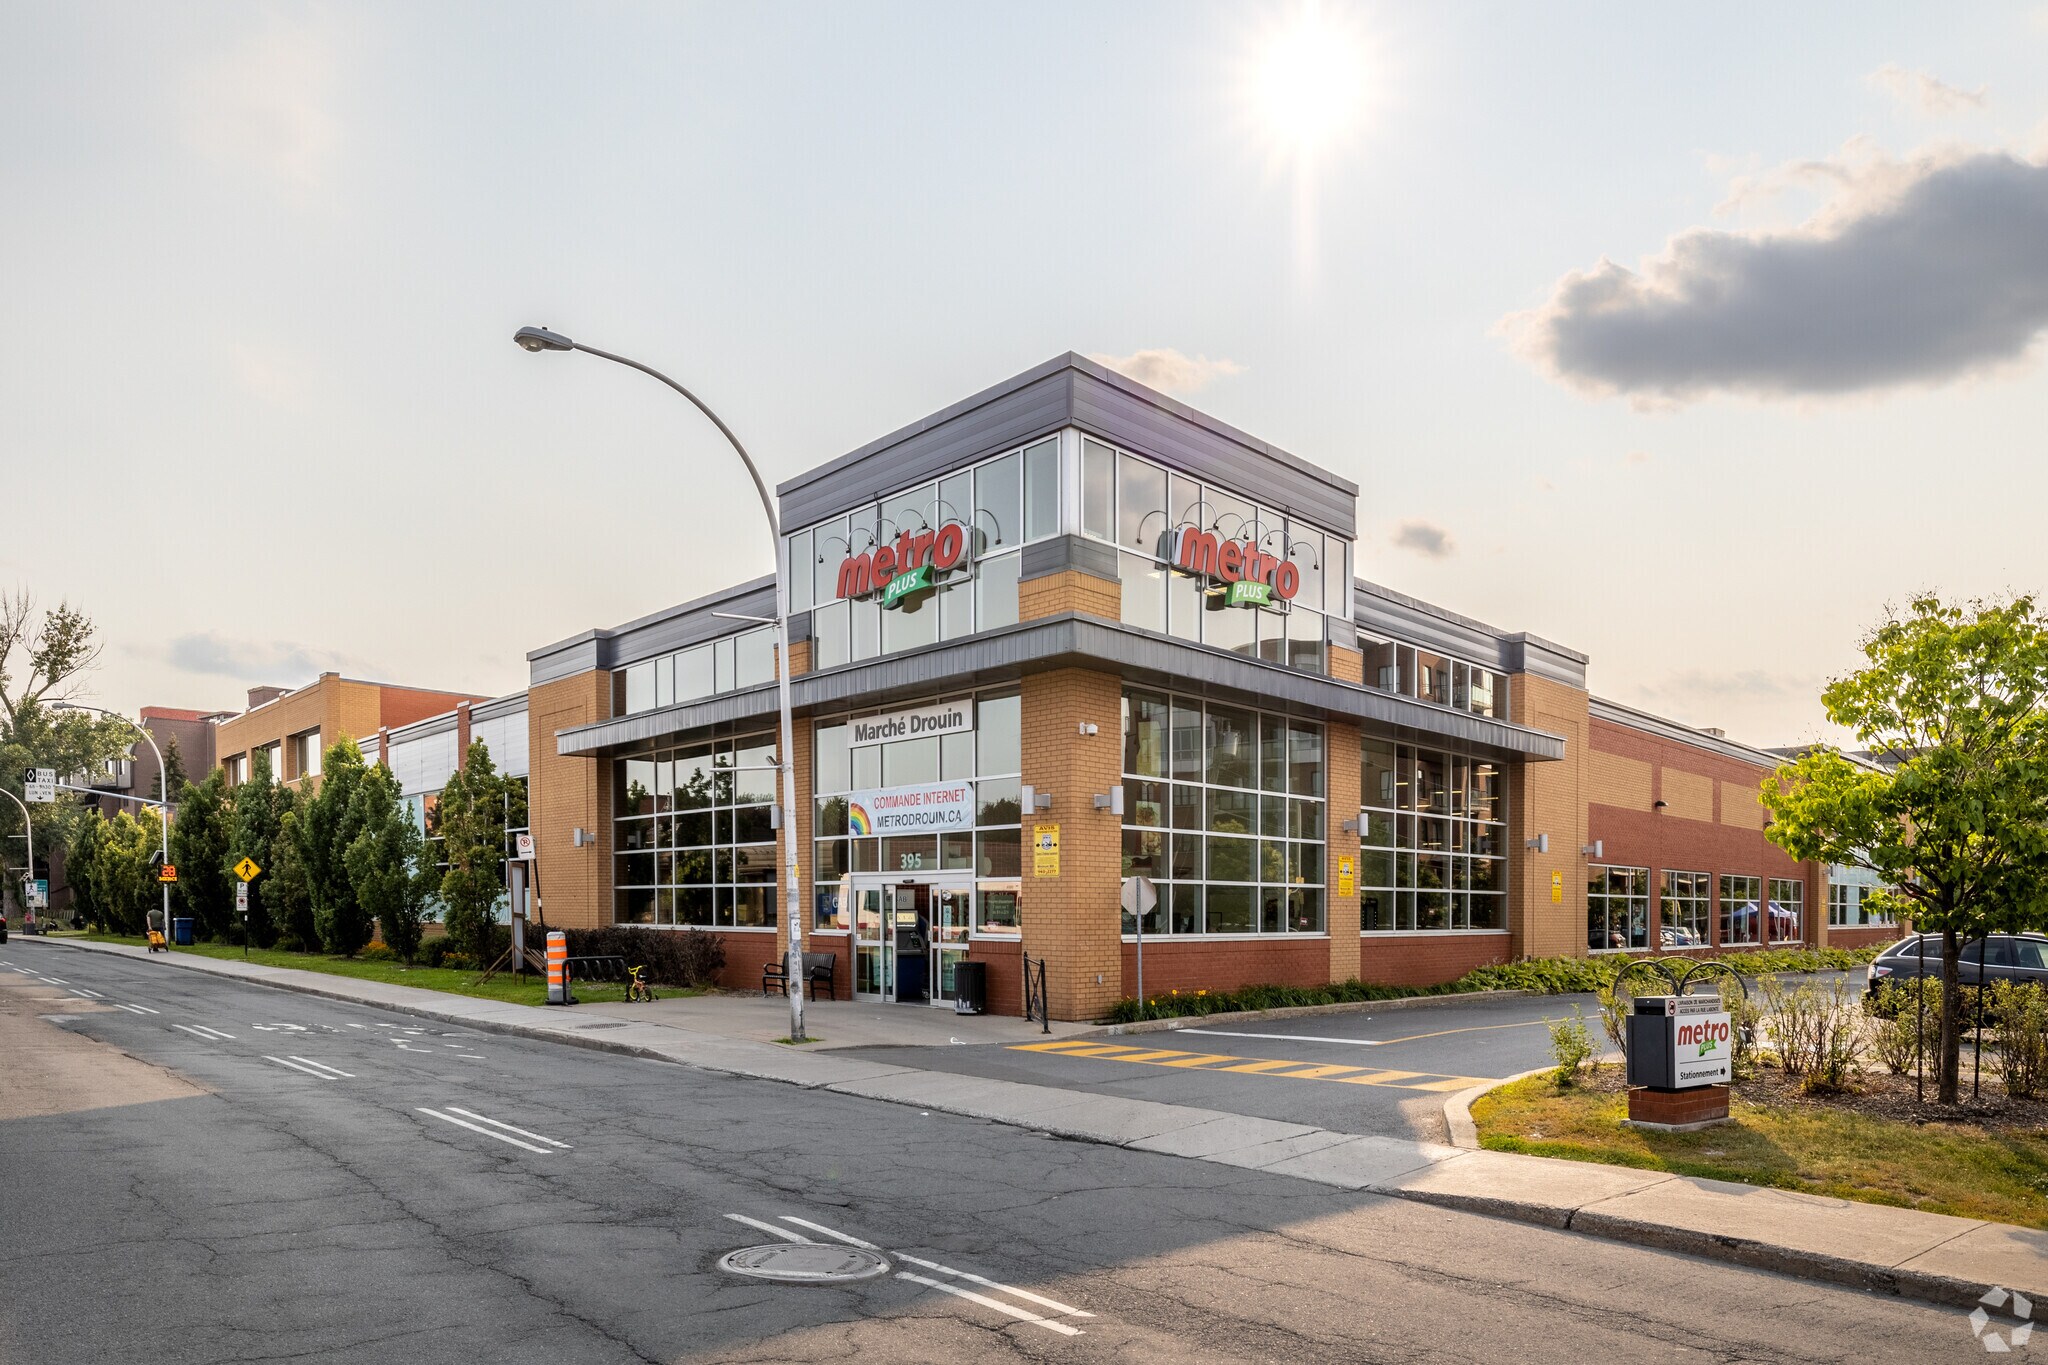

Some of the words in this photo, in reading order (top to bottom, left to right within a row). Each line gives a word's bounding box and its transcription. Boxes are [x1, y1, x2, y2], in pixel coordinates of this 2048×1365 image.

[836, 523, 963, 599] metro
[1179, 527, 1300, 599] metro
[888, 572, 917, 599] PLUS
[1236, 584, 1263, 599] PLUS
[855, 716, 906, 742] Marché
[910, 708, 963, 734] Drouin
[873, 793, 921, 810] COMMANDE
[923, 788, 966, 804] INTERNET
[876, 810, 962, 828] METRODROUIN.CA
[900, 853, 922, 869] 395
[1678, 1020, 1729, 1046] metro
[1700, 1041, 1713, 1051] PLUS
[1680, 1069, 1719, 1080] Stationnement
